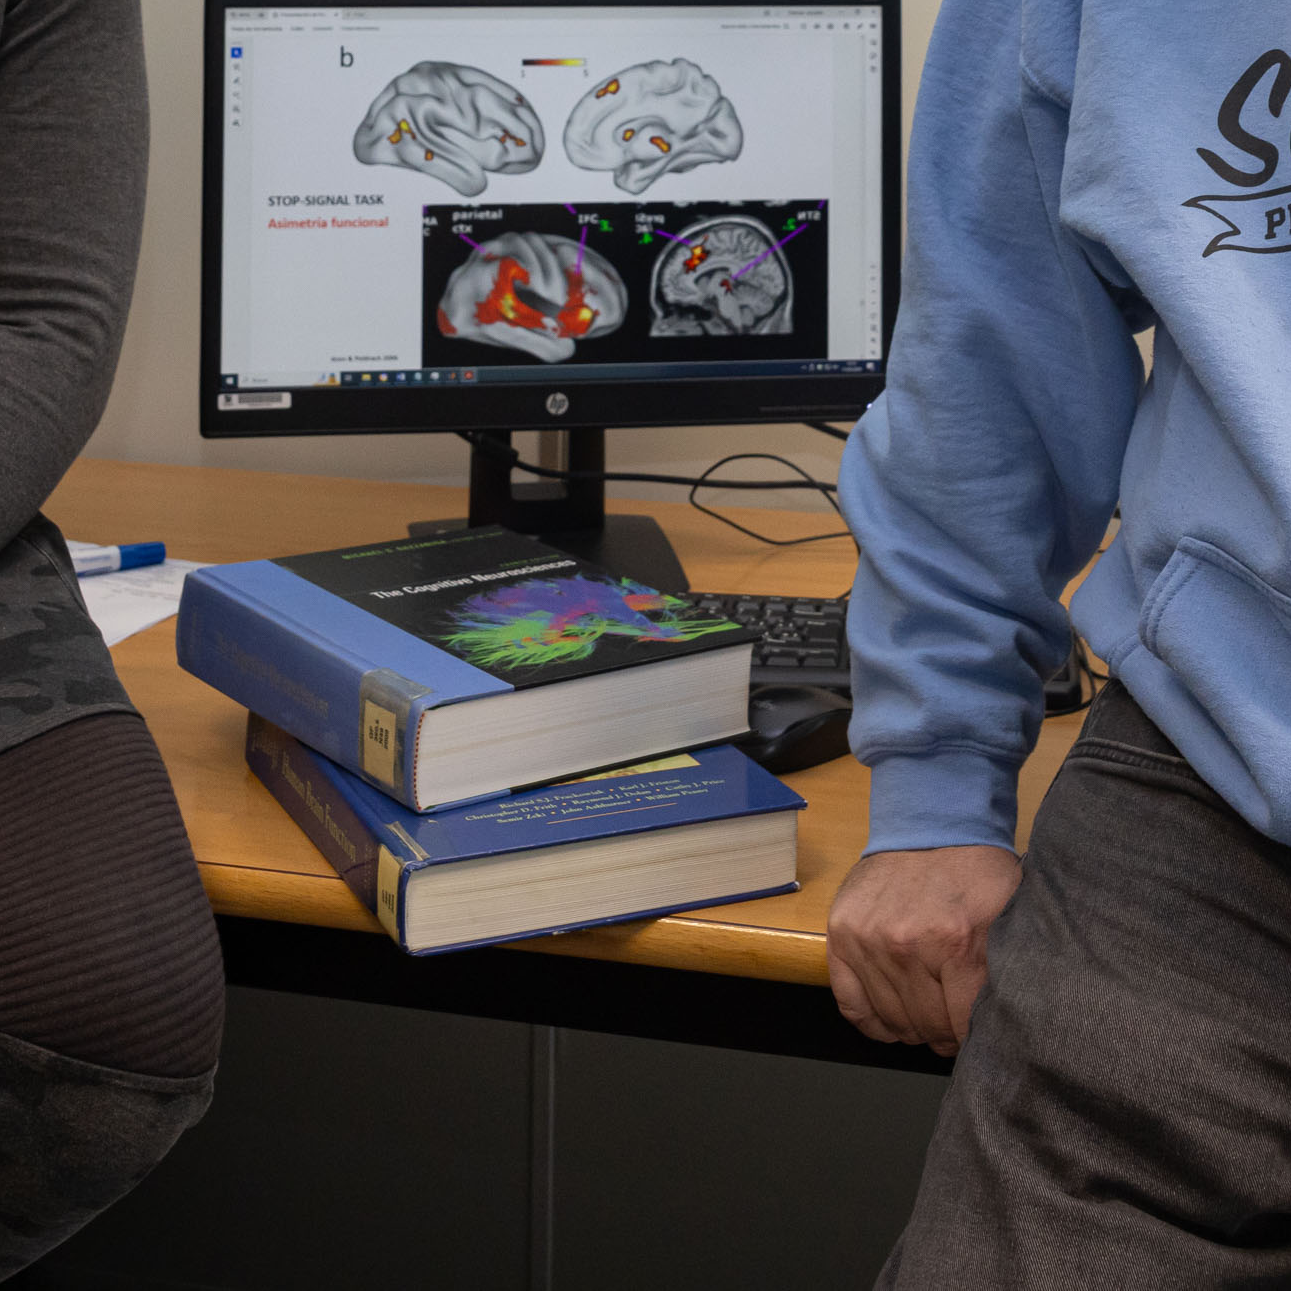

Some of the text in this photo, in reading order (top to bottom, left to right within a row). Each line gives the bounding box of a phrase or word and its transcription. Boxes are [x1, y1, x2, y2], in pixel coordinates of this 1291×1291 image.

[340, 45, 354, 68] b
[268, 194, 385, 207] STOP-SIGNAL TASK
[267, 217, 390, 229] Asimetria funcional
[451, 209, 503, 221] parietal
[369, 589, 404, 601] The
[402, 576, 474, 595] Cognitive
[472, 559, 578, 583] Neurosciences
[464, 809, 519, 822] Christopher
[534, 803, 558, 811] Frith
[572, 795, 614, 807] Raymond
[498, 799, 534, 809] Richard
[560, 807, 583, 815] John
[645, 793, 680, 801] William
